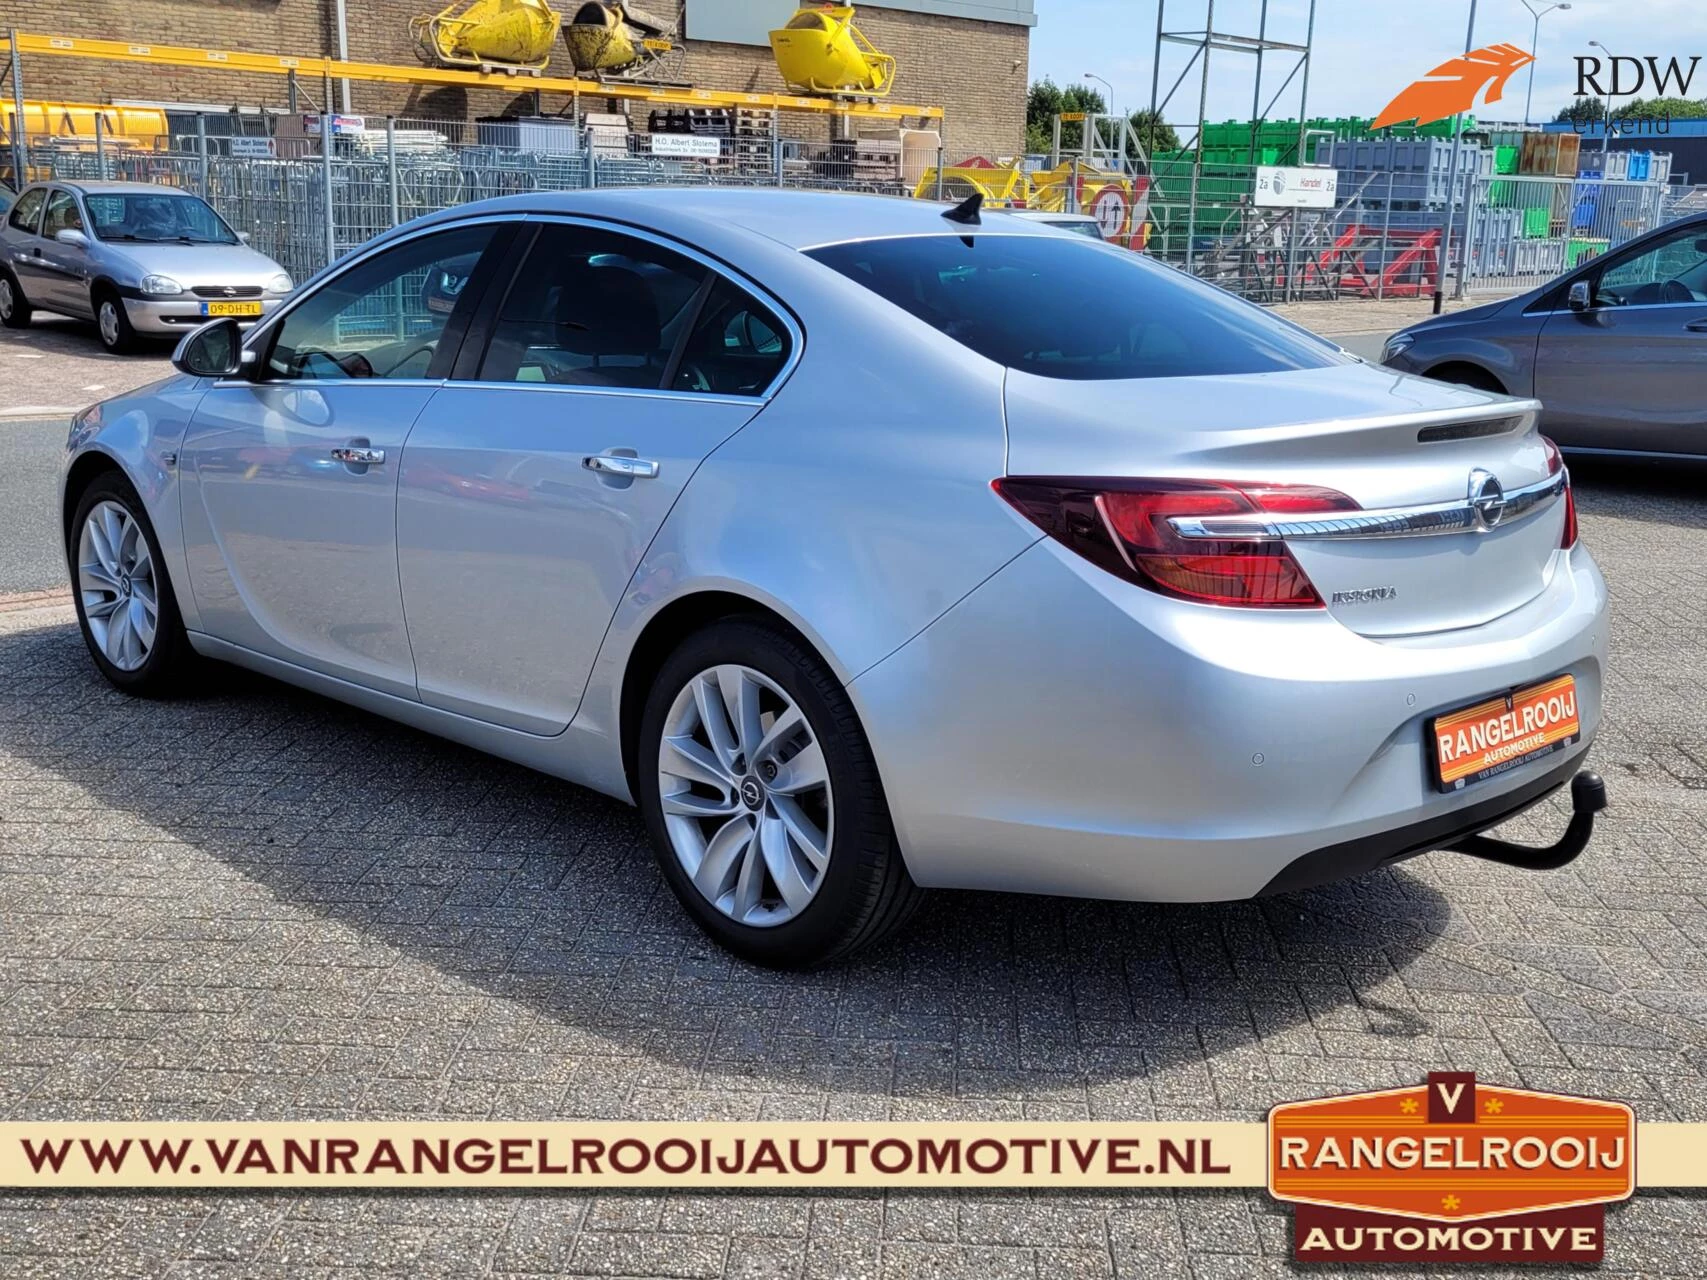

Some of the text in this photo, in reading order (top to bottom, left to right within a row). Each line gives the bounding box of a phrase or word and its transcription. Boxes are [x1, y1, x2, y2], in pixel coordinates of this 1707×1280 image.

[671, 138, 690, 147] Albert
[1259, 178, 1268, 190] 2a
[1300, 177, 1321, 188] Handel
[1326, 181, 1335, 191] 2a
[1332, 586, 1397, 603] INSIGNIA
[1506, 697, 1513, 709] V
[1439, 691, 1576, 763] RANGELROOIJ
[1483, 732, 1545, 765] AUTOMOTIVE
[1478, 767, 1490, 779] VAN
[1524, 745, 1554, 764] AUTOMOTIVE
